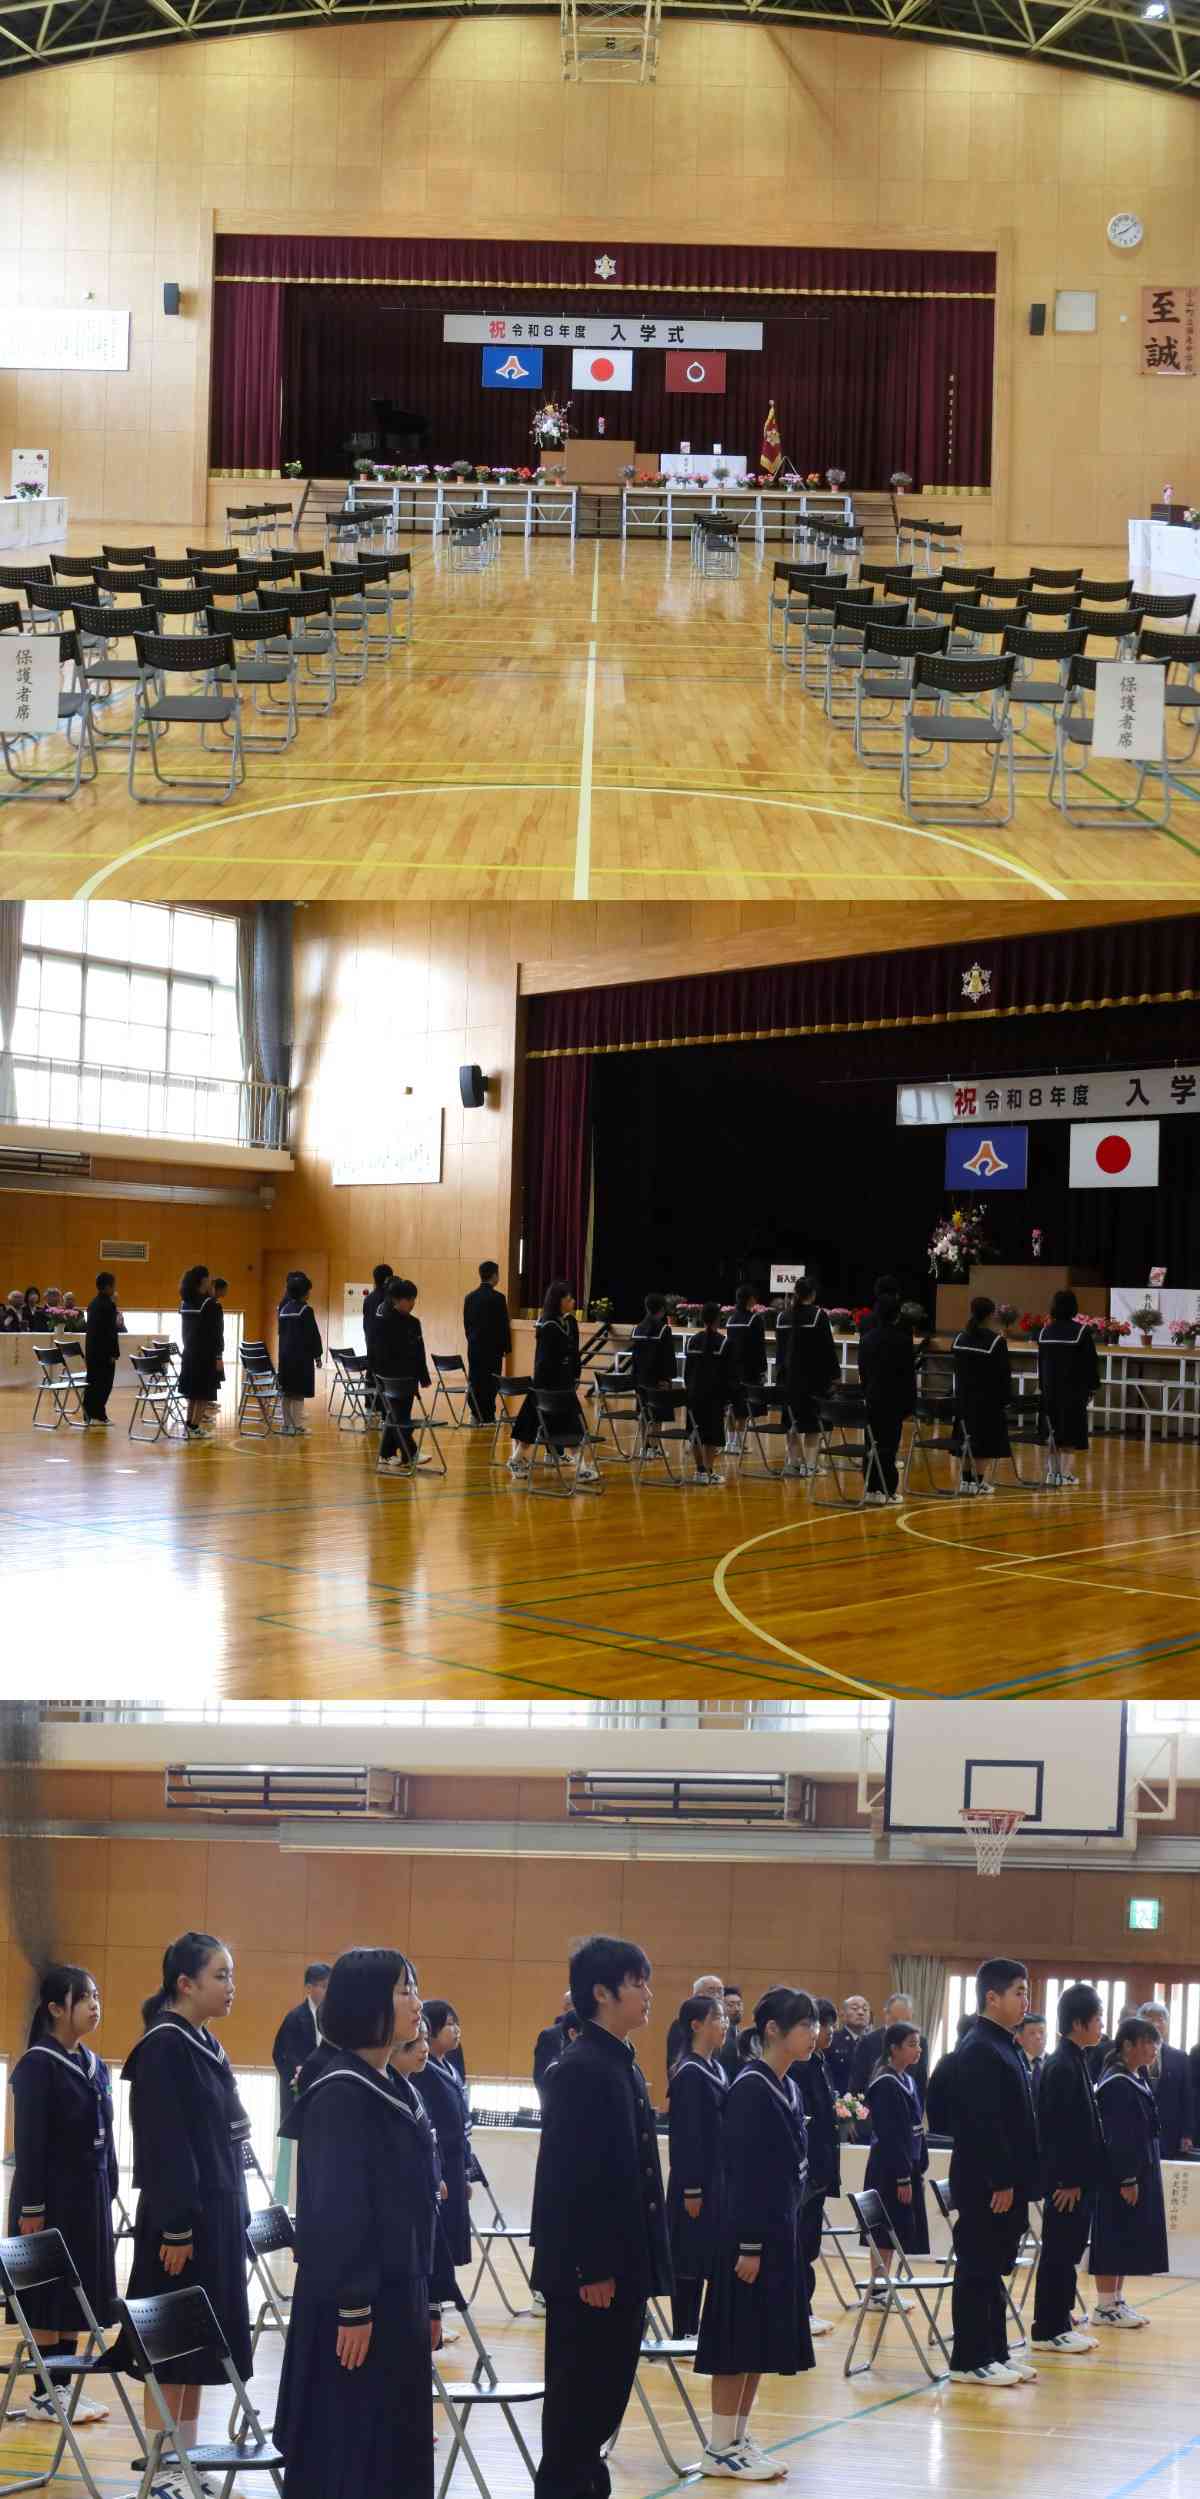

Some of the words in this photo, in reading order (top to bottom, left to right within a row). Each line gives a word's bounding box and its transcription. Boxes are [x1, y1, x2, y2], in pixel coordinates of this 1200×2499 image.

[489, 321, 506, 339] 祝
[511, 323, 586, 339] 令和8年度
[610, 324, 685, 344] 入学式
[1145, 291, 1180, 369] 至誠
[16, 649, 32, 720] 保護者席
[1118, 676, 1136, 749] 保護者席
[955, 1088, 977, 1116] 祝
[984, 1085, 1089, 1111] 令和8年度
[1126, 1075, 1196, 1107] 入学
